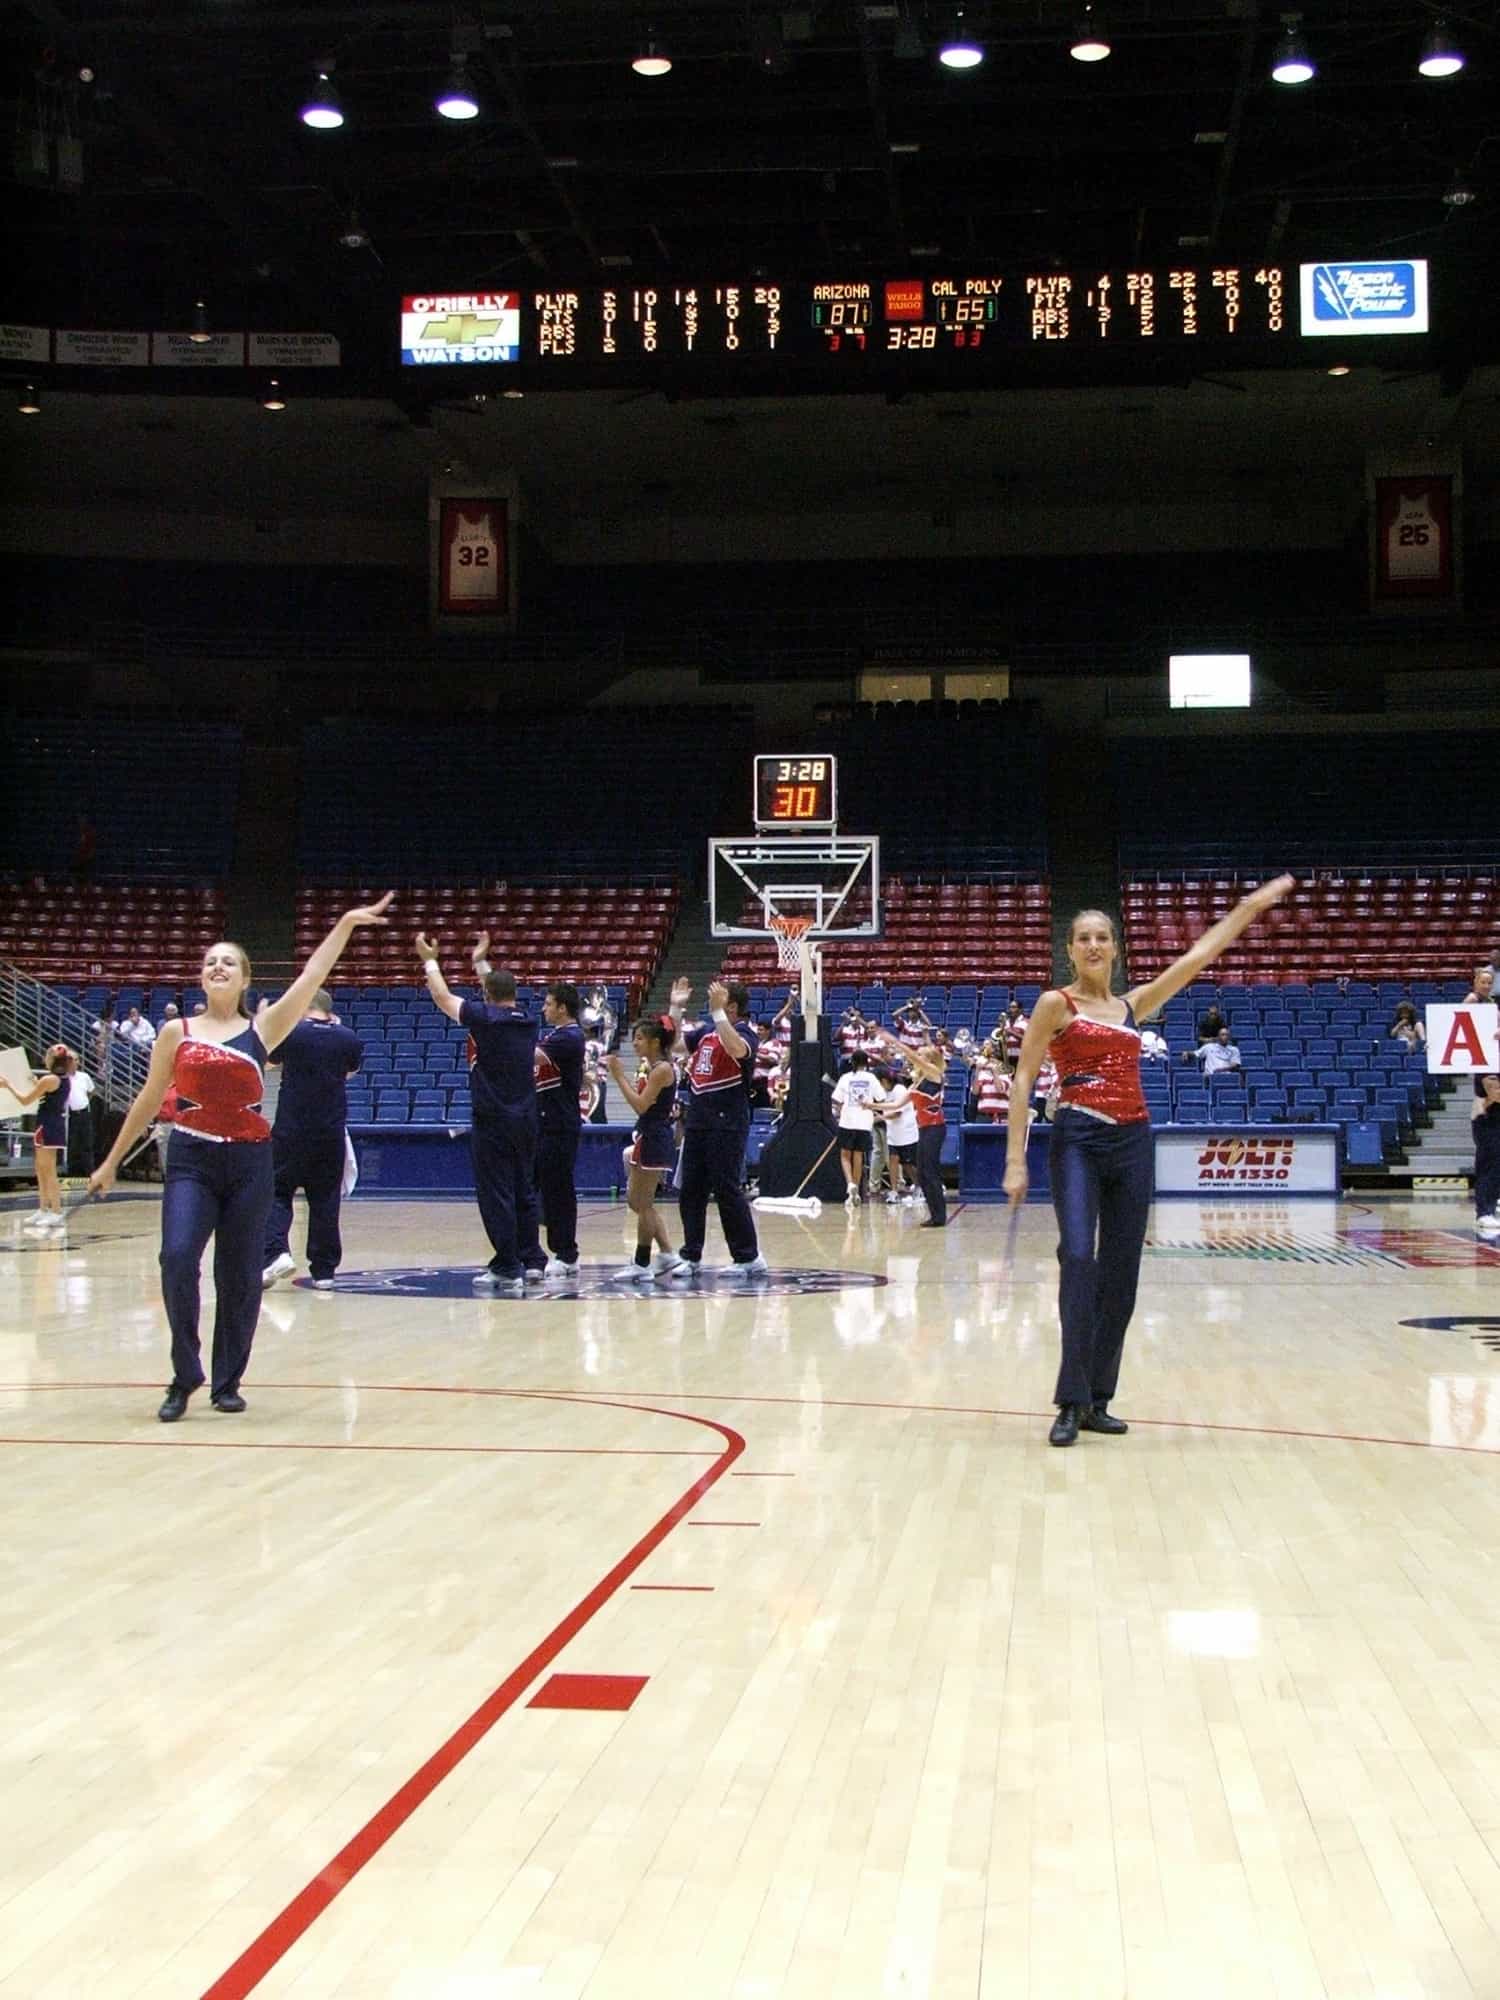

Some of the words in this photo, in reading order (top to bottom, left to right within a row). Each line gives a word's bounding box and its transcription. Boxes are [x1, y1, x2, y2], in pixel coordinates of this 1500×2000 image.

[814, 284, 870, 300] ARIZONA
[931, 281, 958, 296] CAL
[966, 279, 1002, 295] POLY
[1026, 277, 1071, 294] PLYR
[1097, 275, 1111, 290] 4
[1127, 273, 1153, 290] 20
[1169, 272, 1196, 288] 22
[1212, 270, 1239, 287] 25
[1255, 269, 1281, 285] 40
[412, 295, 509, 313] O'RIELLY
[535, 293, 578, 310] PLYR
[634, 290, 657, 306] 10
[675, 289, 698, 306] 14
[716, 288, 739, 304] 15
[755, 287, 780, 304] 20
[888, 293, 921, 301] WELLS
[1035, 293, 1065, 308] PTS
[1088, 290, 1105, 307] 11
[1130, 289, 1153, 305] 12
[1226, 286, 1239, 301] 0
[1269, 285, 1281, 300] 0
[1350, 299, 1407, 313] Power
[543, 309, 573, 324] PTS
[603, 308, 616, 322] 0
[634, 306, 652, 322] 11
[726, 304, 739, 319] 0
[831, 303, 859, 325] 87
[956, 299, 985, 321] 65
[1033, 308, 1068, 324] RBS
[1098, 306, 1111, 322] 3
[1141, 305, 1153, 321] 5
[1183, 303, 1196, 318] 4
[1226, 302, 1239, 317] 0
[540, 324, 575, 340] RBS
[644, 321, 657, 336] 5
[685, 320, 697, 336] 3
[768, 318, 780, 334] 3
[887, 326, 936, 349] 3:28
[1033, 323, 1068, 340] FLS
[1183, 318, 1197, 334] 2
[1269, 316, 1282, 331] 0
[412, 346, 509, 363] WATSON
[540, 339, 575, 356] FLS
[603, 338, 616, 353] 2
[644, 337, 657, 352] 0
[726, 335, 739, 350] 0
[1399, 524, 1429, 546] 25
[458, 546, 489, 567] 32
[777, 761, 825, 781] 3:28
[773, 786, 816, 817] 30
[1440, 1011, 1489, 1066] A
[697, 1046, 713, 1076] A
[1198, 1138, 1295, 1166] JOLT!
[1199, 1168, 1235, 1180] AM
[1238, 1168, 1289, 1180] 1330
